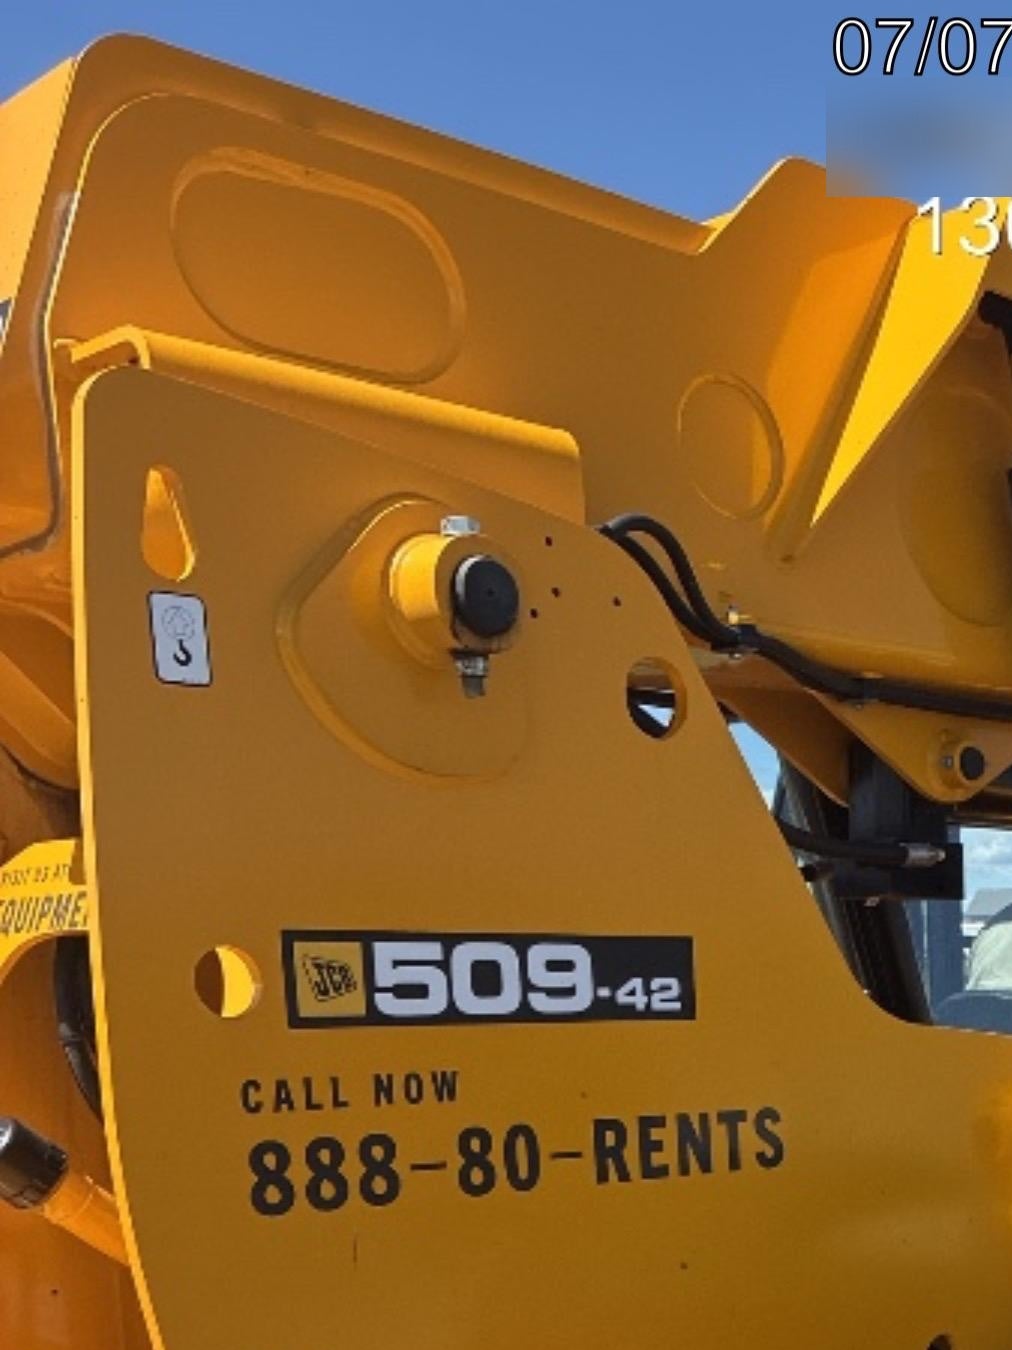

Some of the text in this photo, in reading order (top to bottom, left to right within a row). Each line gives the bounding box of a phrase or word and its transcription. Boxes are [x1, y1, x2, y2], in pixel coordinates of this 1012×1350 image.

[240, 1071, 460, 1114] CALL NOW
[248, 1107, 785, 1216] 888-80-RENTS
